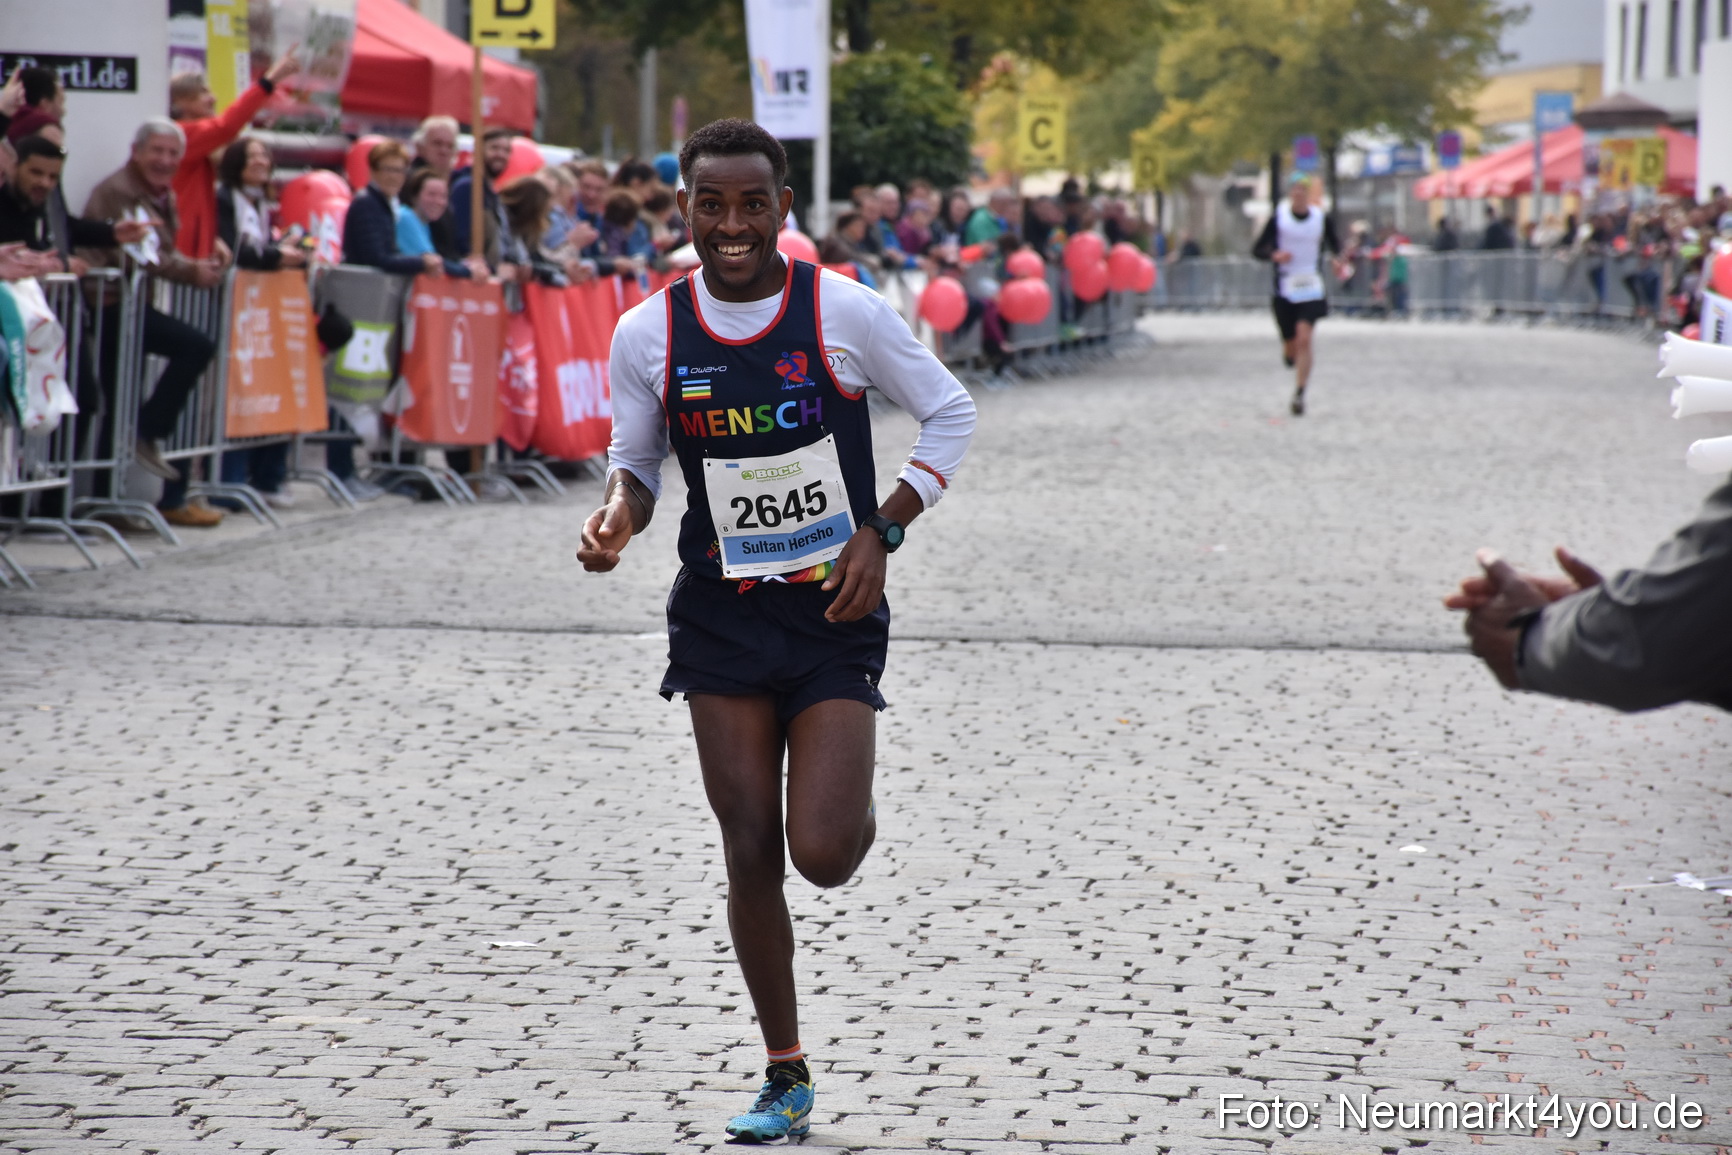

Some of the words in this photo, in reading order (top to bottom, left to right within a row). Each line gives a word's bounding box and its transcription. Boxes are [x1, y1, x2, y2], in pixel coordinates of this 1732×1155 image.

[0, 56, 128, 89] -rtl.de
[1029, 116, 1052, 150] C
[343, 327, 391, 374] B
[678, 396, 823, 437] MENSCH
[755, 461, 802, 479] BOCK
[730, 479, 827, 529] 2645
[742, 540, 785, 555] Sultan
[788, 525, 834, 552] Hersho
